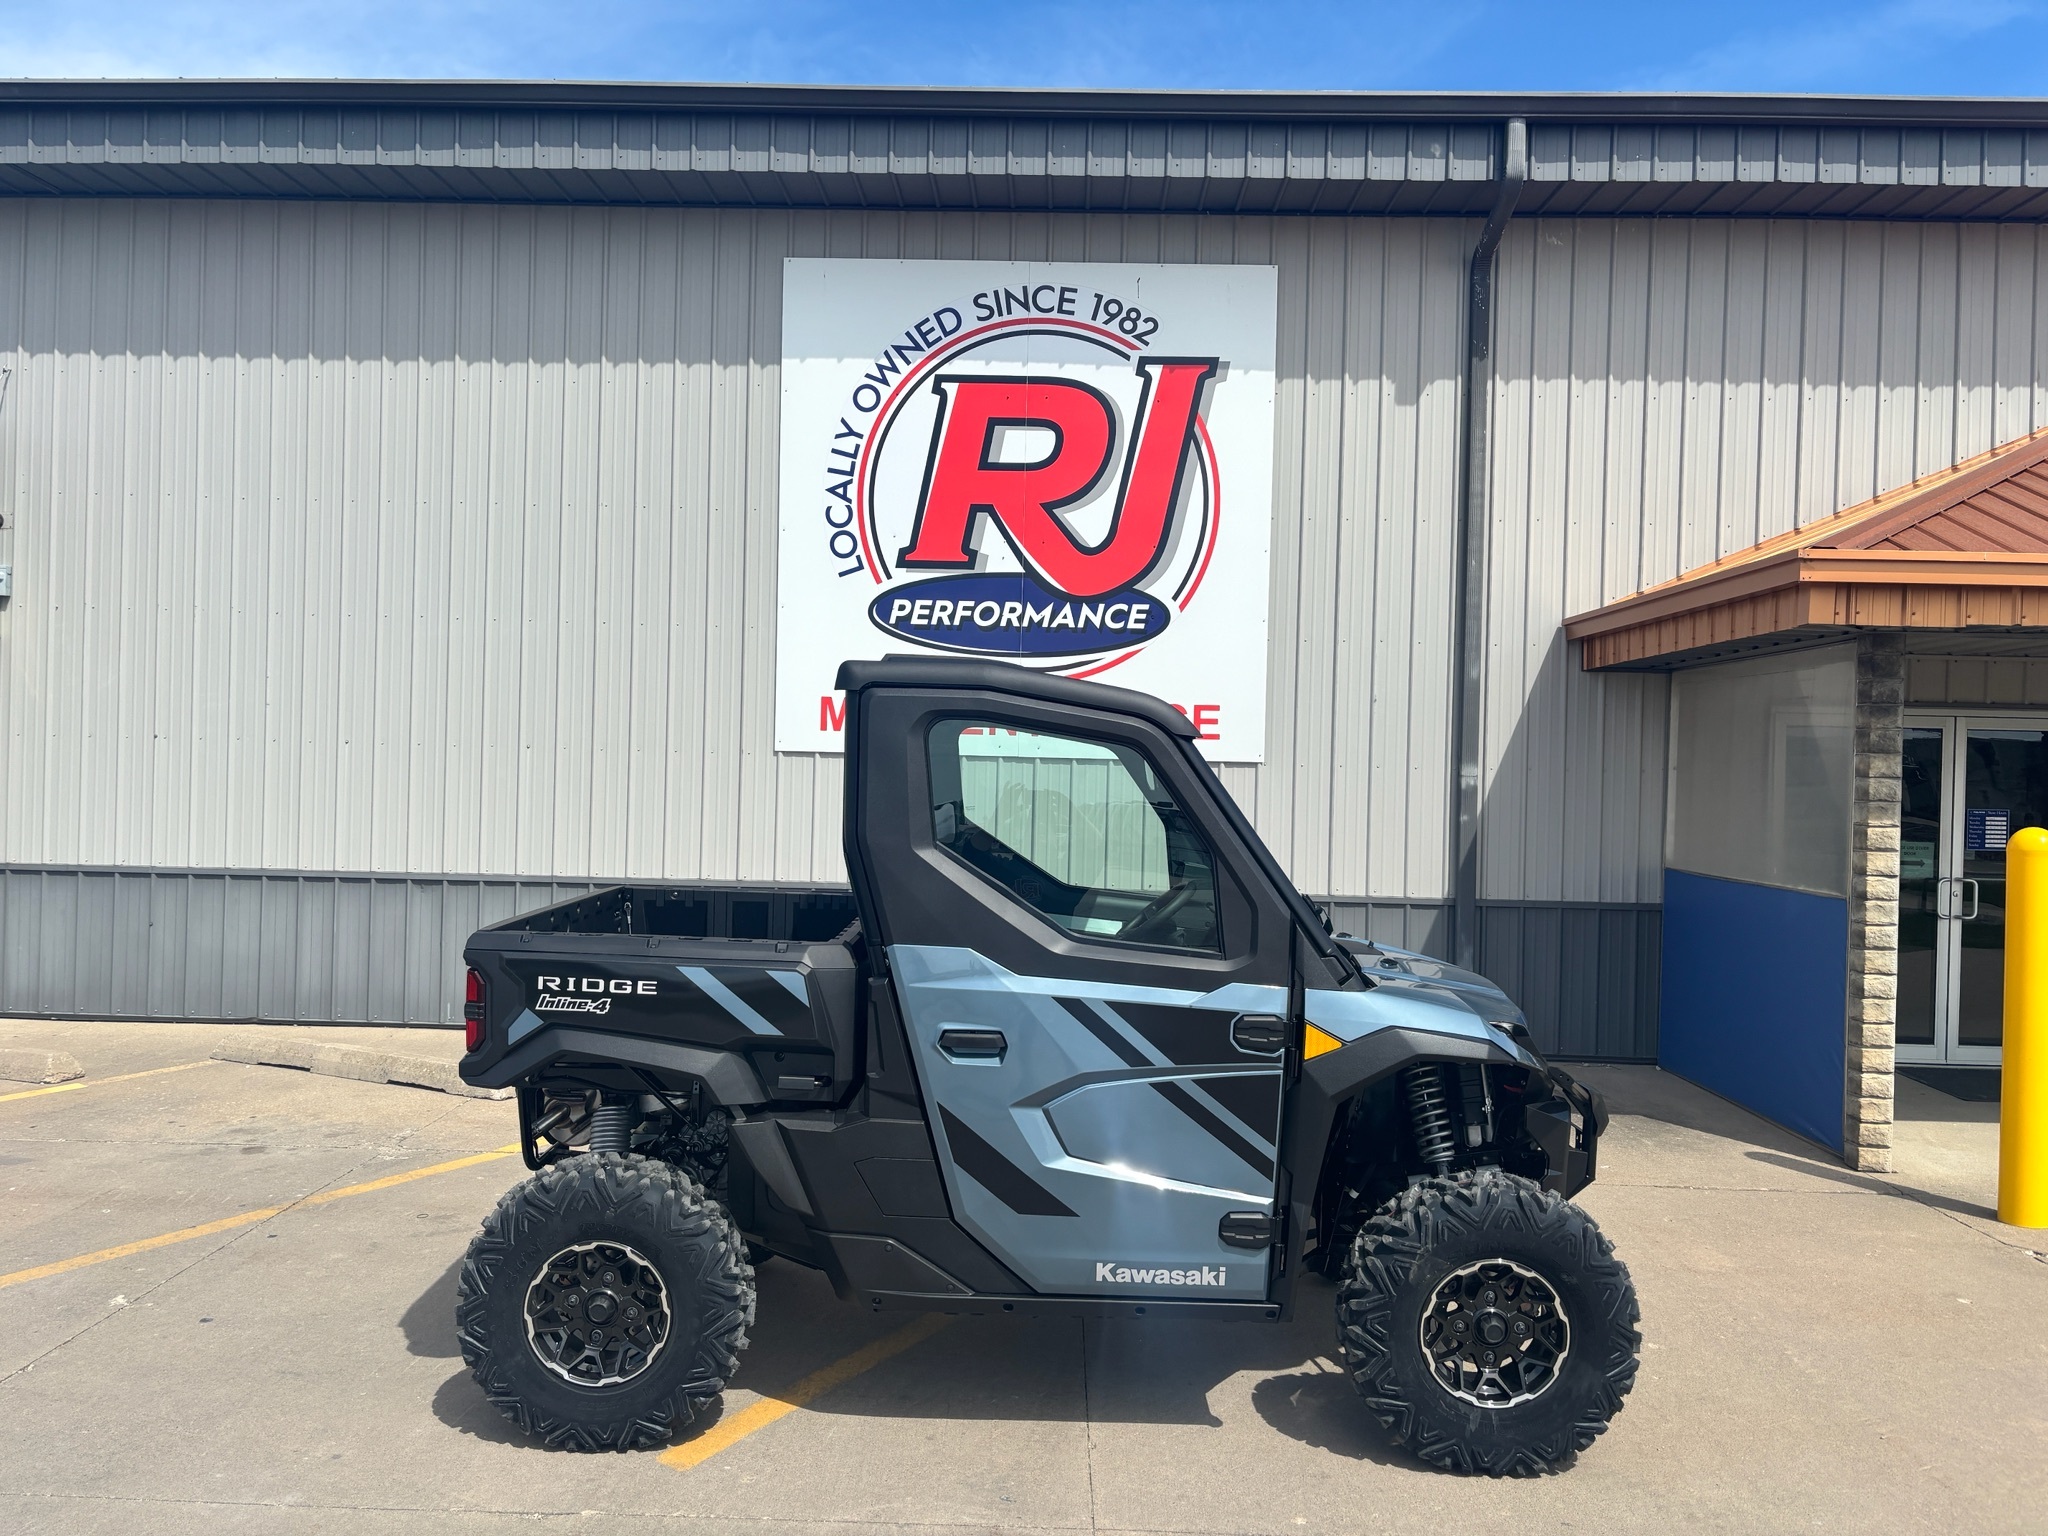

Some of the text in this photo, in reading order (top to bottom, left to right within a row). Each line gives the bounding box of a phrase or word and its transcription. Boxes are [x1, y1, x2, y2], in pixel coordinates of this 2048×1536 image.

[825, 284, 1160, 578] LOCALLY OWNED SINCE 1982
[896, 356, 1221, 599] RJ
[888, 598, 1151, 630] PERFORMANCE
[537, 975, 658, 995] RIDGE
[535, 993, 612, 1015] Inline-4
[1095, 1262, 1226, 1286] Kawasaki
